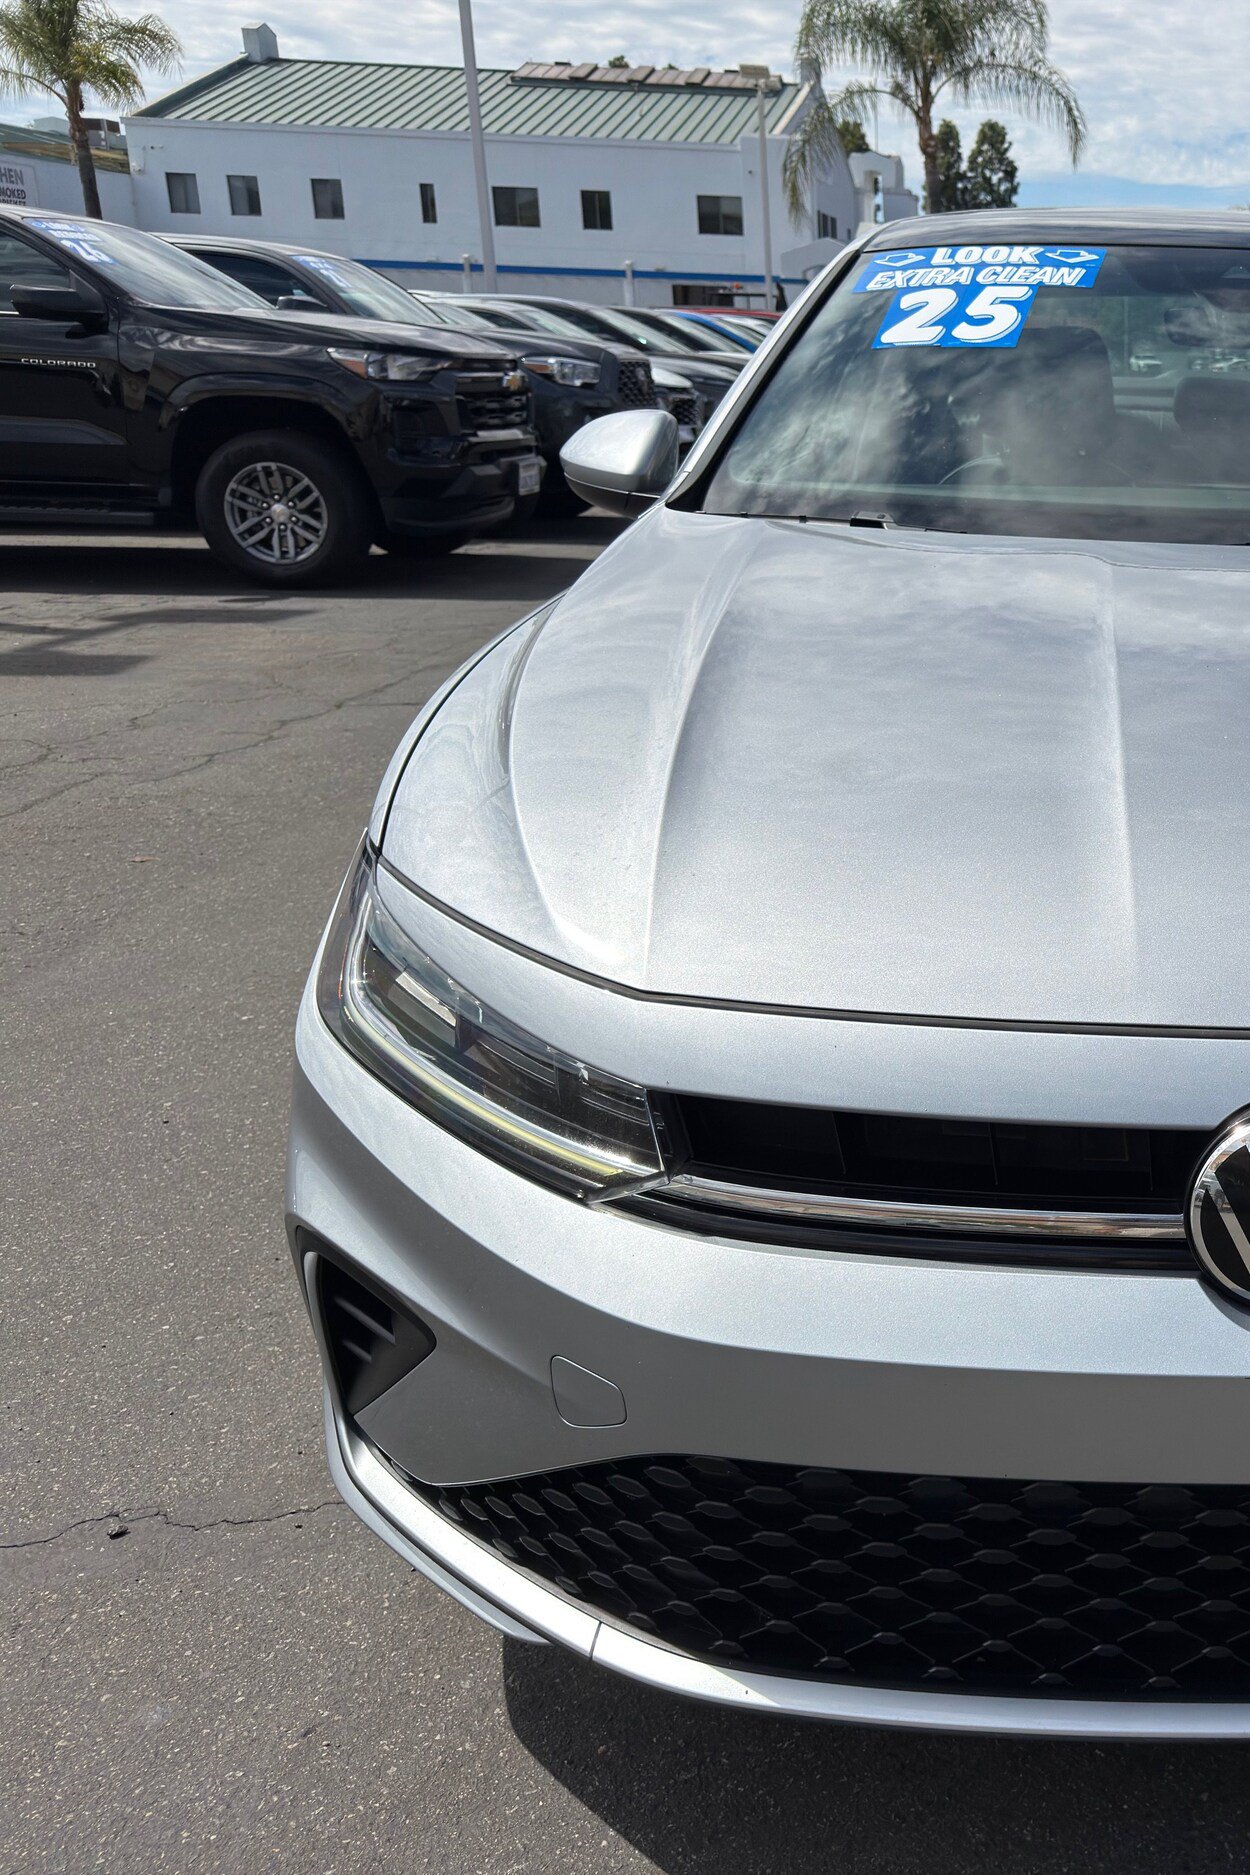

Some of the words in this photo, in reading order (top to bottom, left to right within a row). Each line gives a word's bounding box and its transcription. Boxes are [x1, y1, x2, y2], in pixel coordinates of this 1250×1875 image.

[930, 246, 1045, 265] LOOK
[866, 267, 975, 291] EXTRA
[975, 265, 1088, 287] CLEAN
[880, 285, 1033, 345] 25
[21, 358, 96, 368] COLORADO
